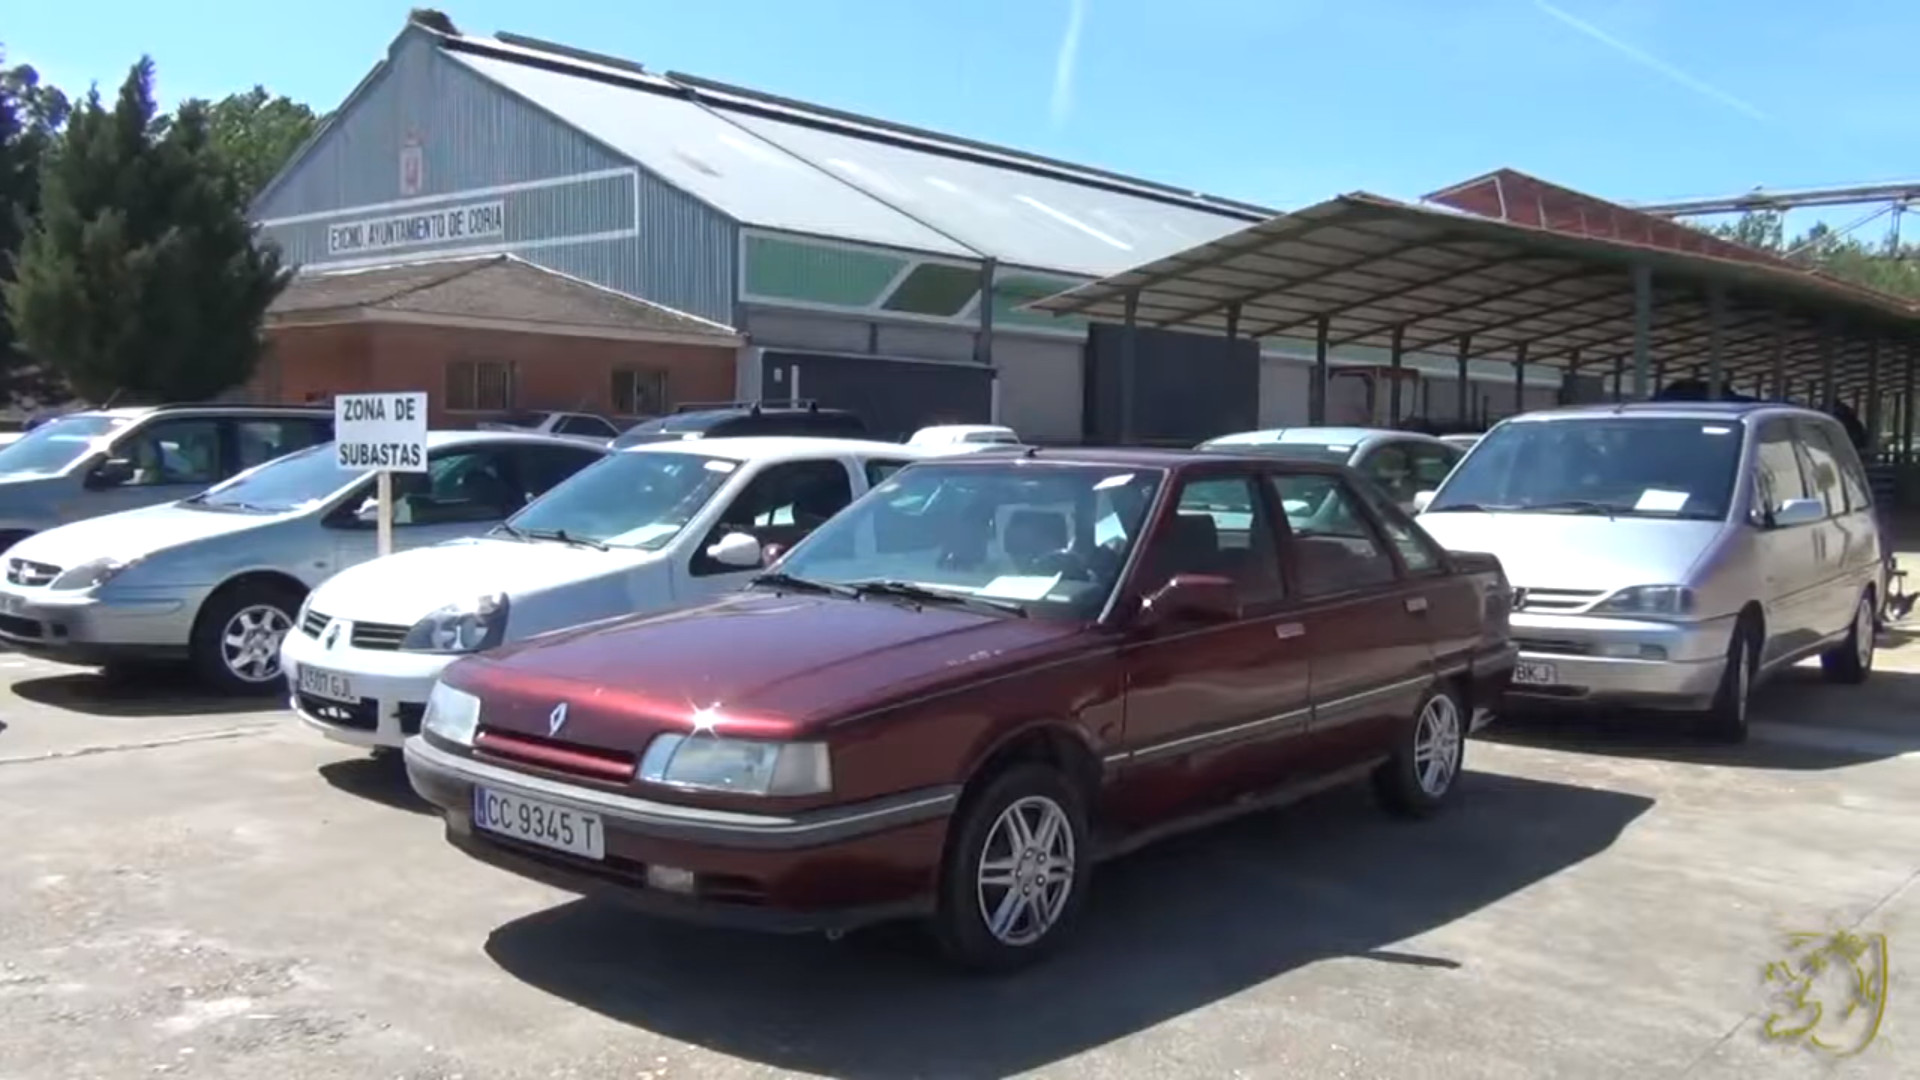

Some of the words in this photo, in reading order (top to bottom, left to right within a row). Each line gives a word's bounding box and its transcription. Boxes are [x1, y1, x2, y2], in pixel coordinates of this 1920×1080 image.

[368, 213, 445, 245] AYUNTAMIENTO
[449, 211, 464, 236] DE
[468, 205, 502, 234] CORIA
[343, 398, 386, 421] ZONA
[395, 397, 416, 421] DE
[339, 443, 421, 467] SUBASTAS
[488, 794, 512, 829] CC
[518, 803, 574, 845] 9345
[581, 817, 595, 850] T
